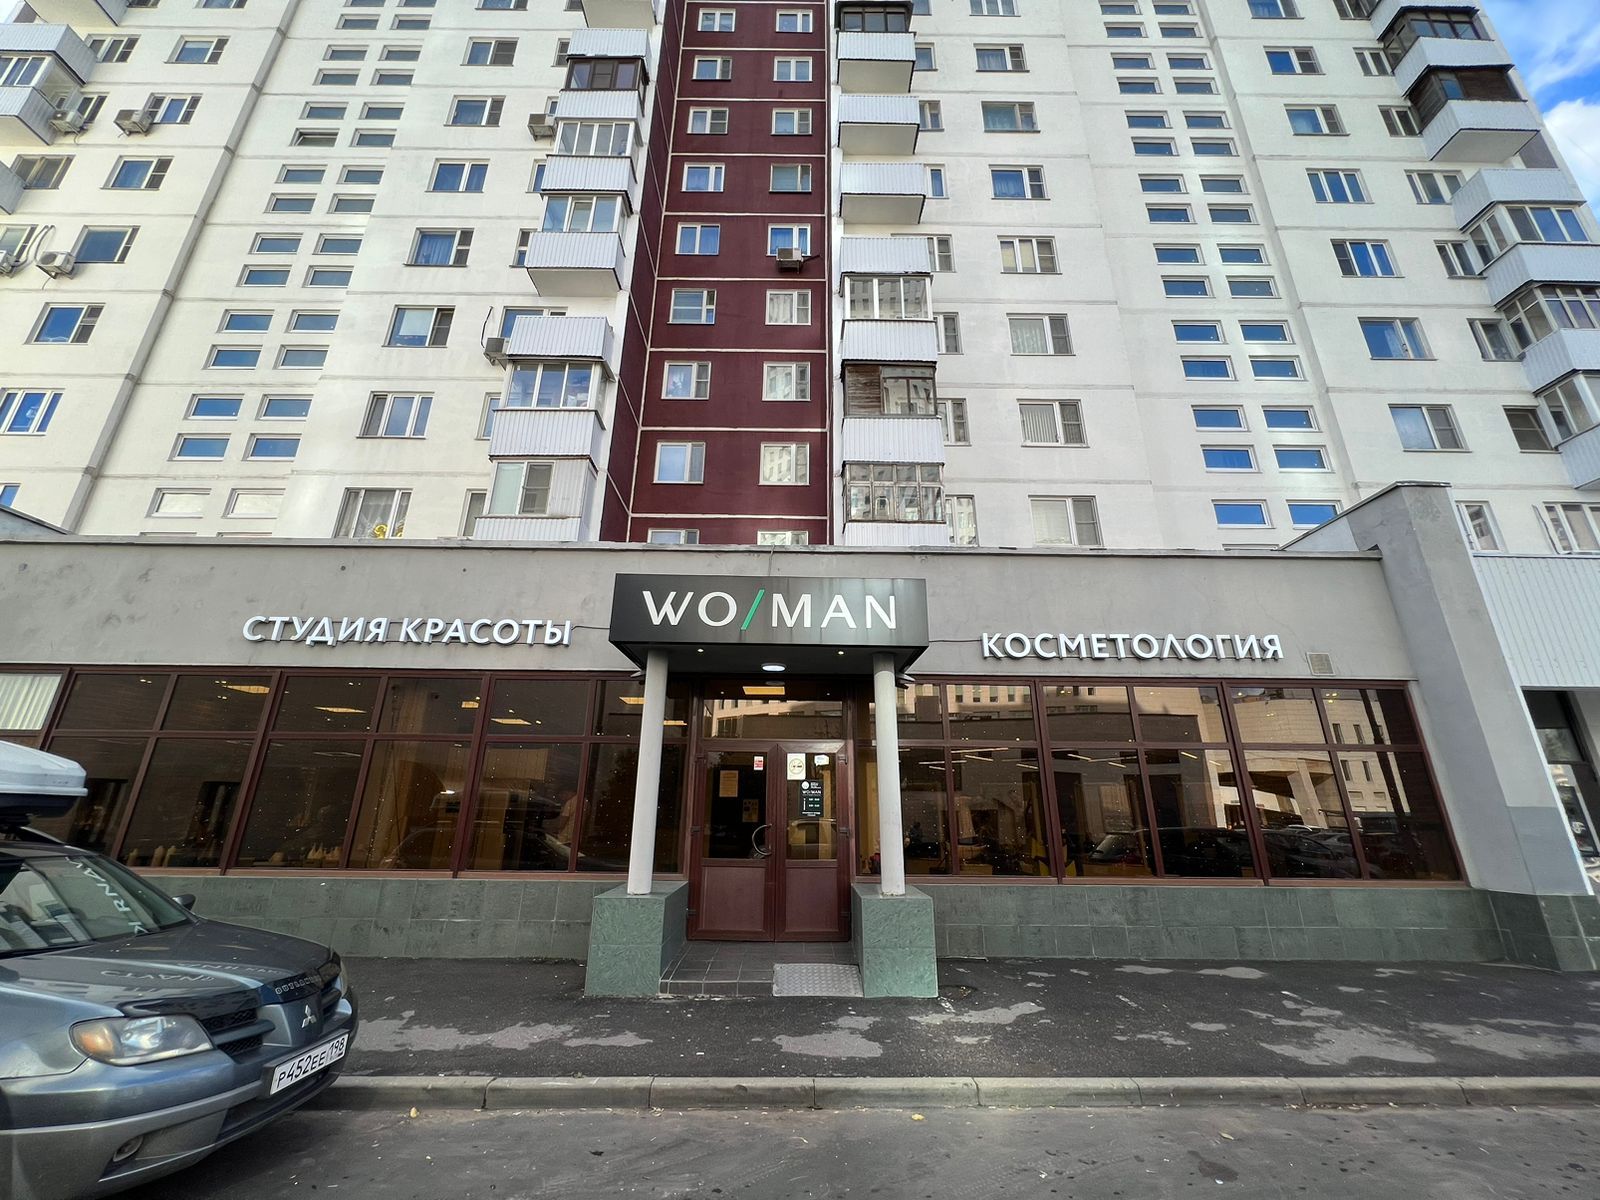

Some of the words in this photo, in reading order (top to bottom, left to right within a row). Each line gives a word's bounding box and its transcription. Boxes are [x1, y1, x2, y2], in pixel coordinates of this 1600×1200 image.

[642, 588, 897, 631] WO/MAN
[242, 616, 389, 646] СТУДИЯ
[399, 617, 574, 648] КРАСОТЫ
[981, 632, 1285, 661] КОСМЕТОЛОГИЯ
